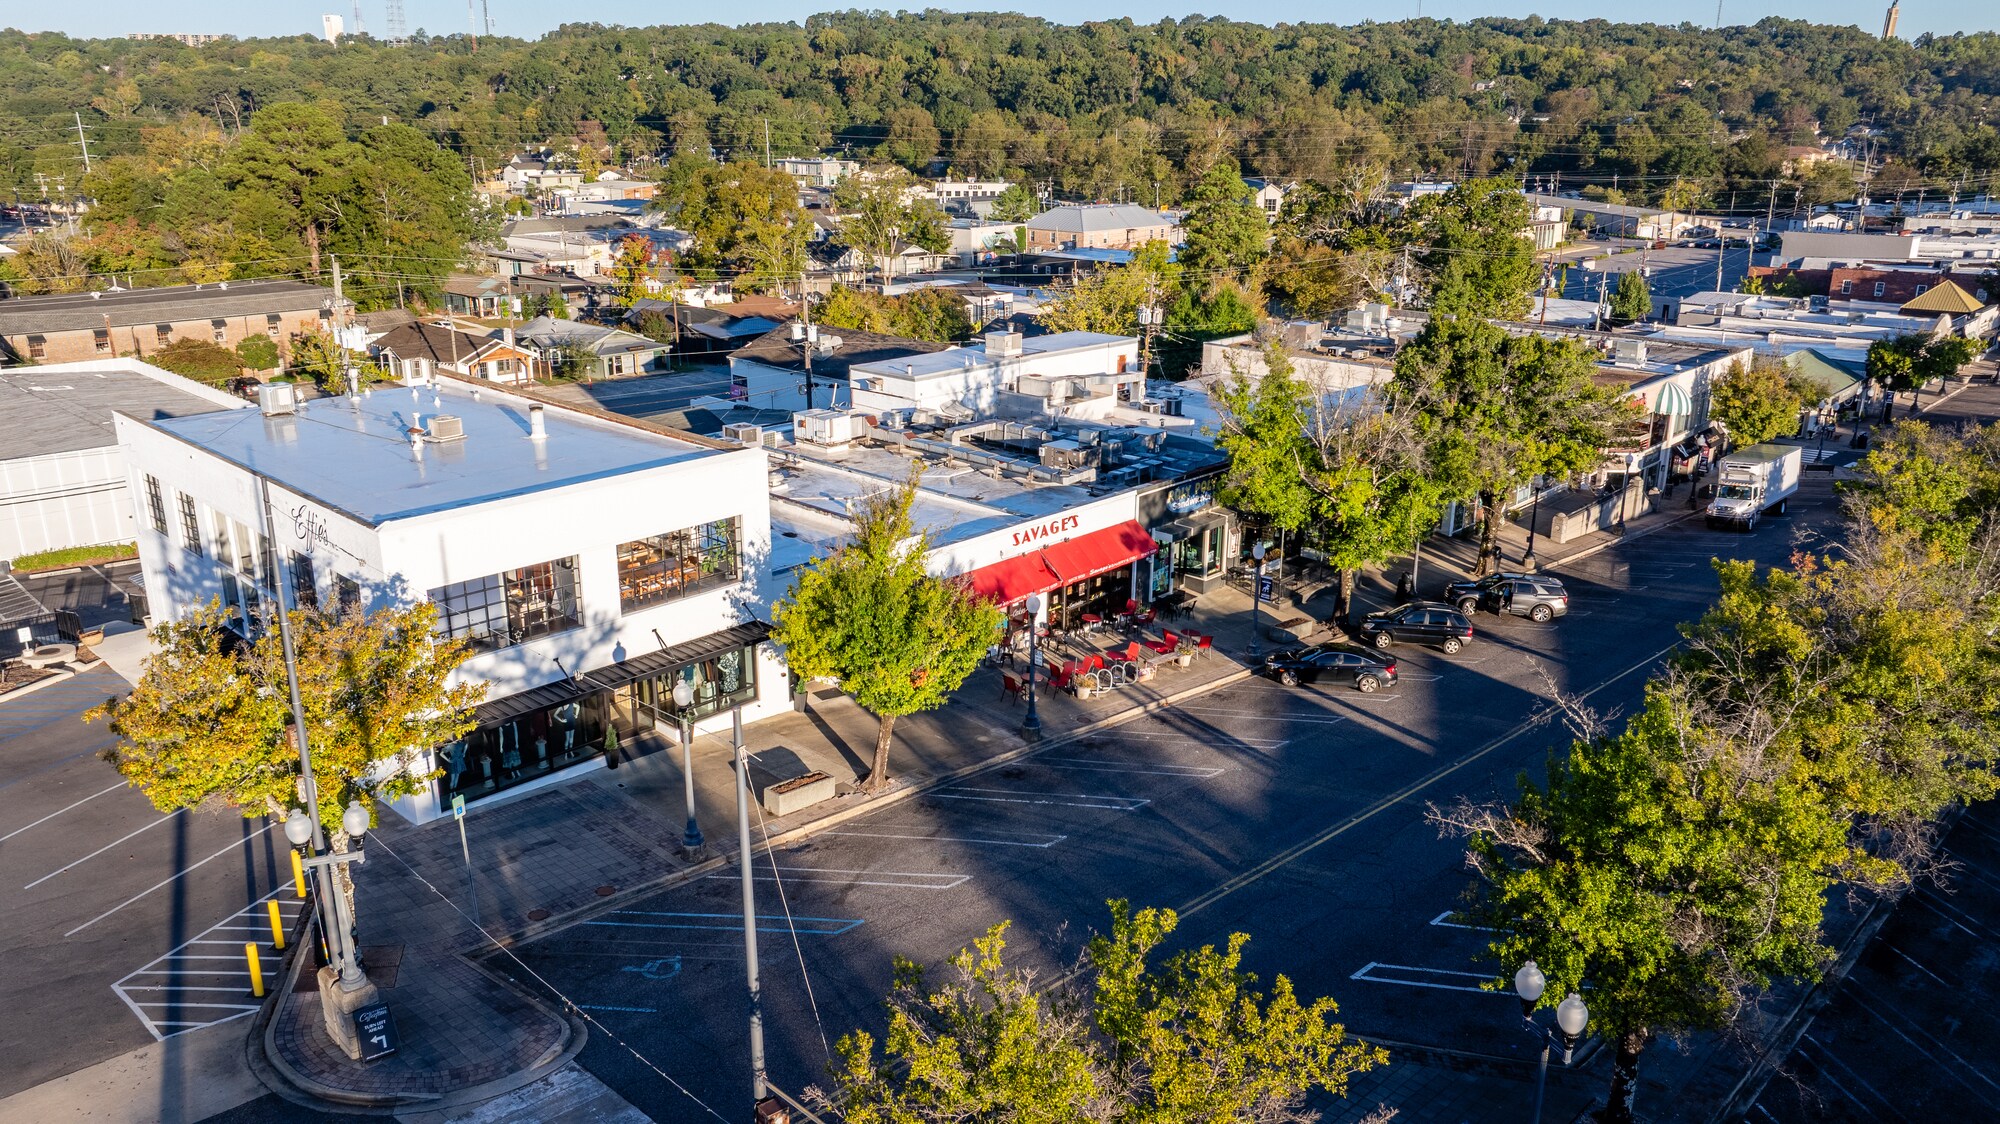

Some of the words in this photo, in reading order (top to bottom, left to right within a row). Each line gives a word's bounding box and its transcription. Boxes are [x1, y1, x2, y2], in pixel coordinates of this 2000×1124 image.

[291, 505, 328, 554] Effie's
[1012, 515, 1079, 547] SAVAGE'S
[368, 1025, 384, 1033] AHEAD
